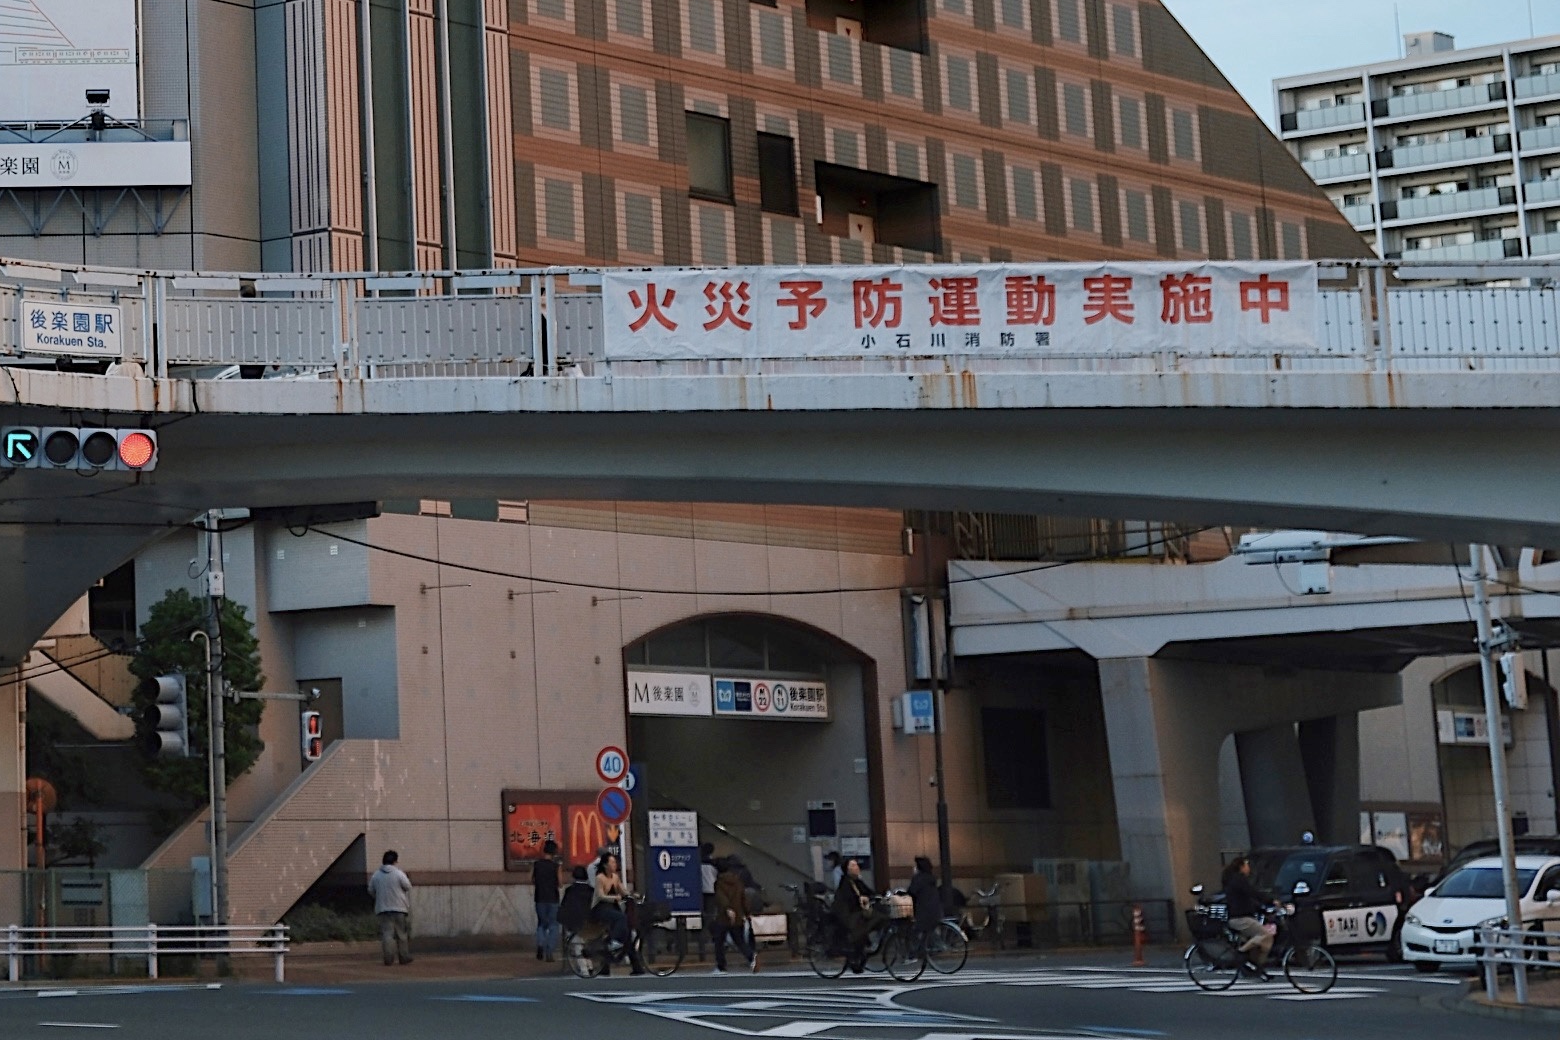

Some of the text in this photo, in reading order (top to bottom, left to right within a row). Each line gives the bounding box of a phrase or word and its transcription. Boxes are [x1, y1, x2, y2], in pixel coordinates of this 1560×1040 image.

[627, 273, 1291, 332] 火災予防運動実施中
[30, 310, 114, 334] 後楽園駅
[37, 333, 107, 349] Korakuen Sta.
[861, 332, 1050, 349] 小石川消防署
[758, 697, 767, 706] 22
[777, 697, 784, 705] 11
[789, 687, 825, 702] 後楽園駅
[603, 757, 621, 773] 40
